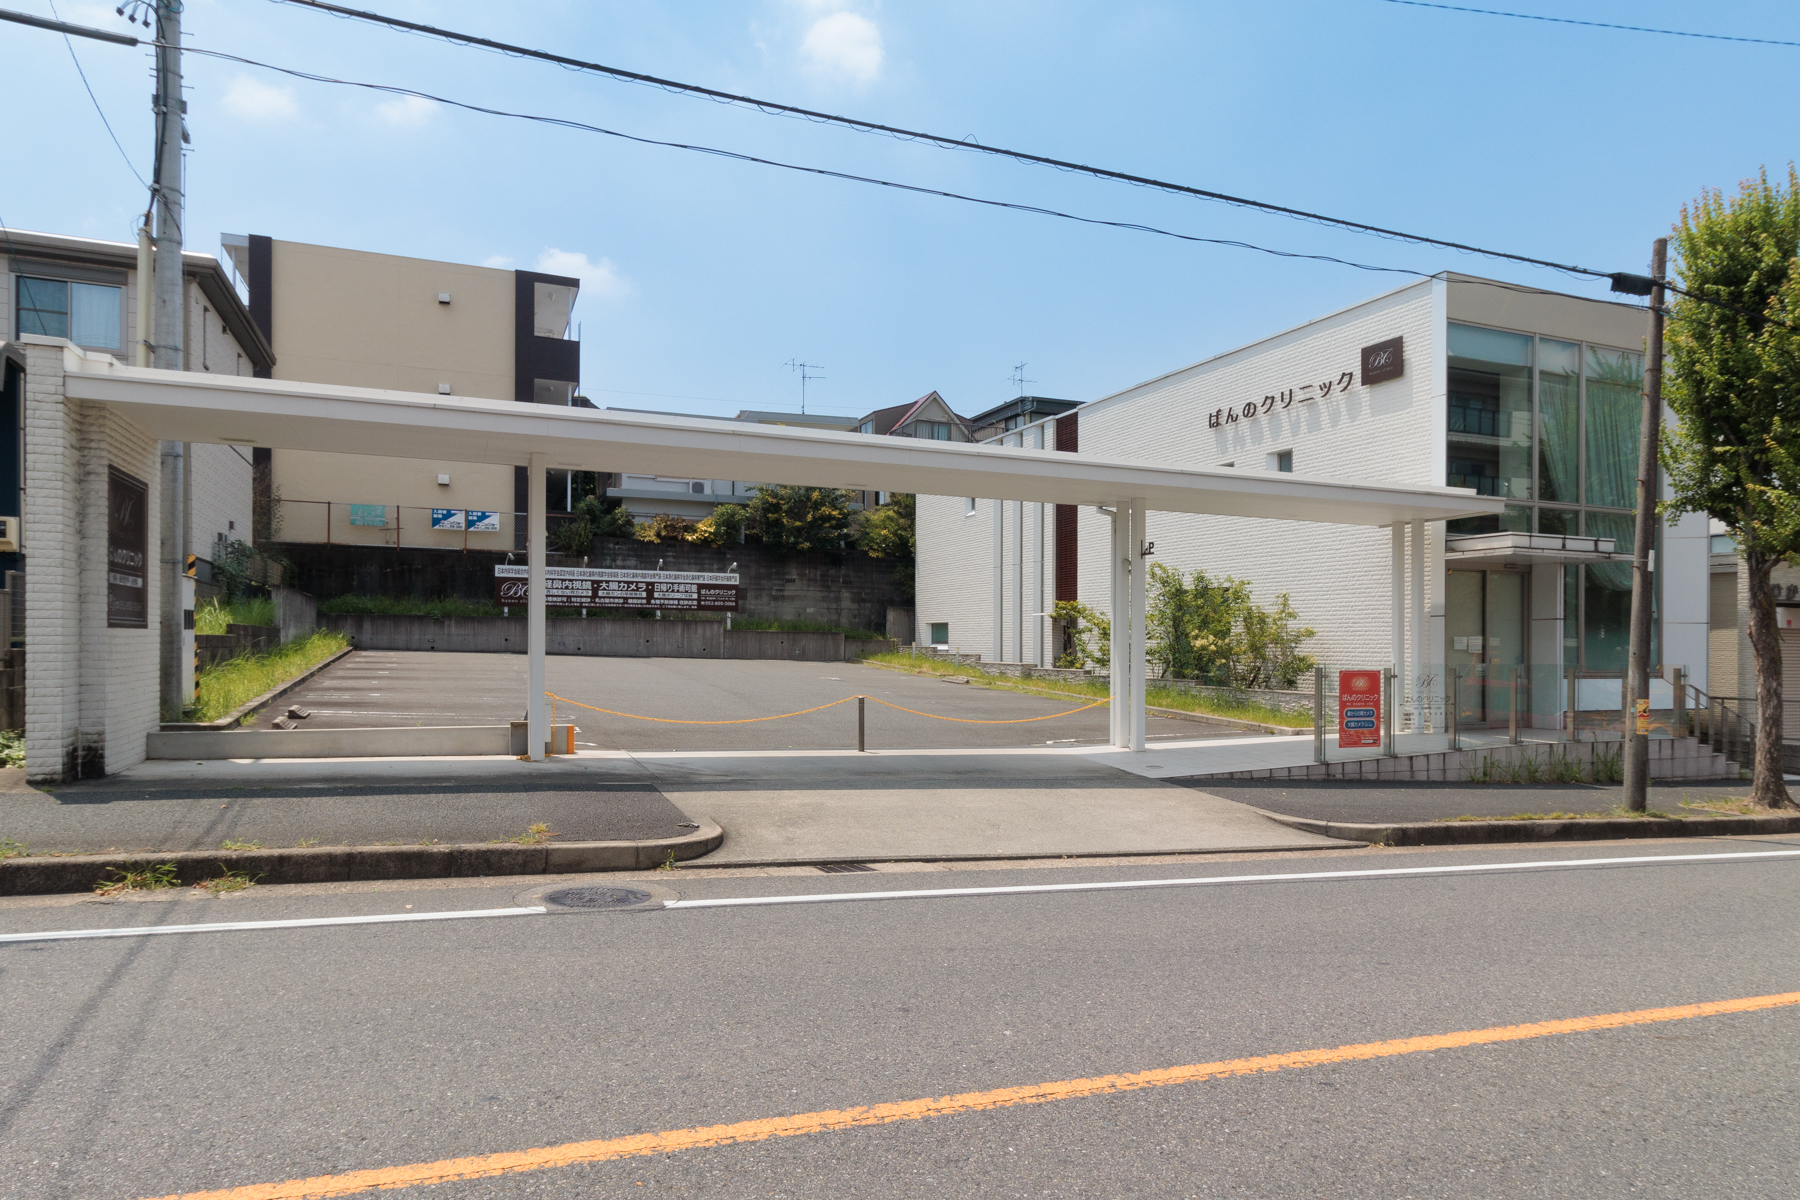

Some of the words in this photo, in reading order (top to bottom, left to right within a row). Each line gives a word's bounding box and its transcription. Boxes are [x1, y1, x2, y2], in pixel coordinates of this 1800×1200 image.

[1208, 372, 1354, 428] ばんのクリニック
